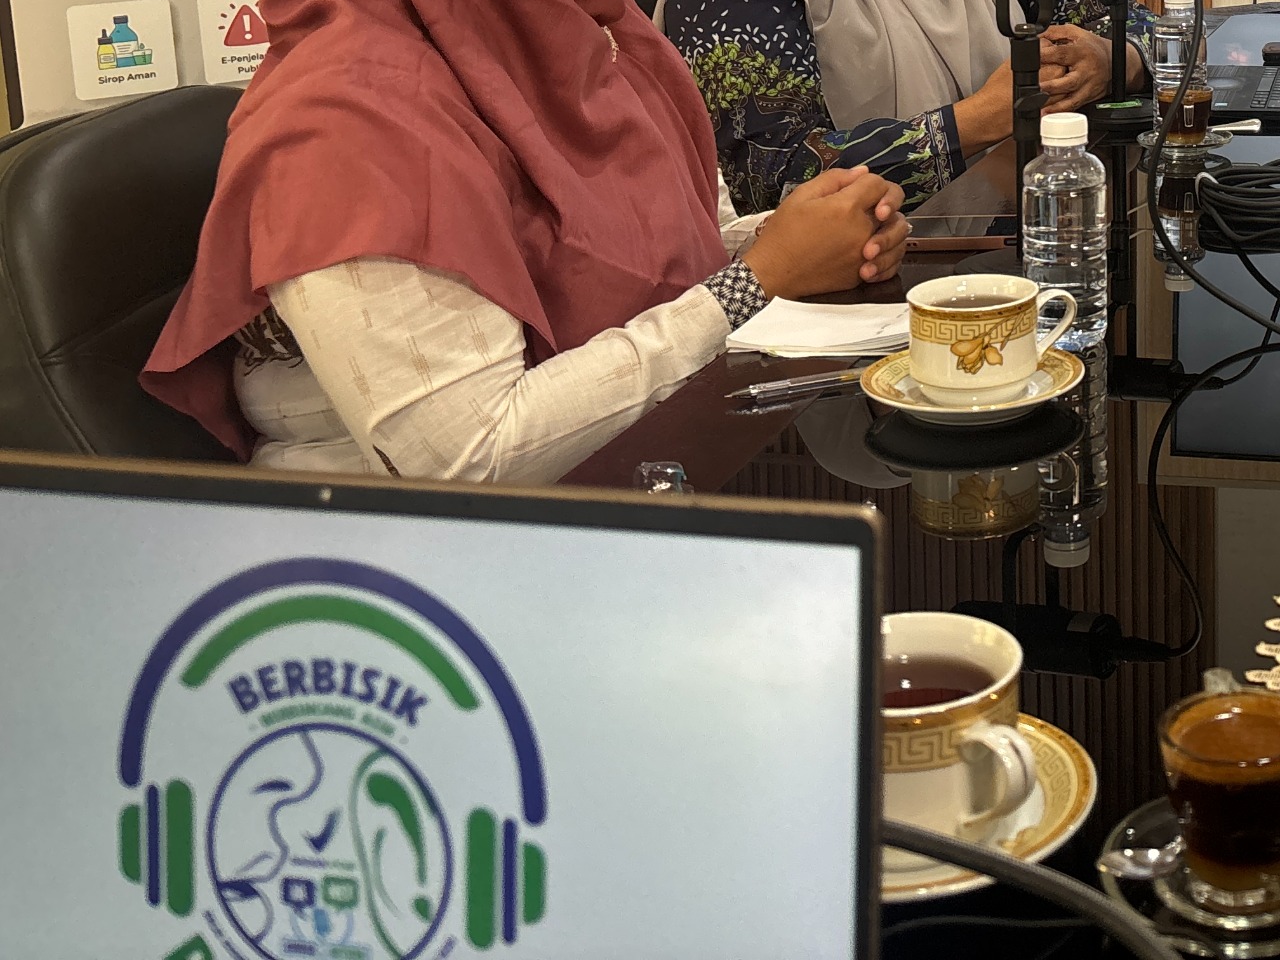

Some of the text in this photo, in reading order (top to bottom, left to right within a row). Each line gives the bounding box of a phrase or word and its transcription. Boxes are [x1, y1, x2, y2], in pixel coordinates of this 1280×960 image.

[222, 53, 268, 65] E-Penjela
[98, 70, 157, 85] Sirop Aman
[229, 658, 429, 726] BERBISIK
